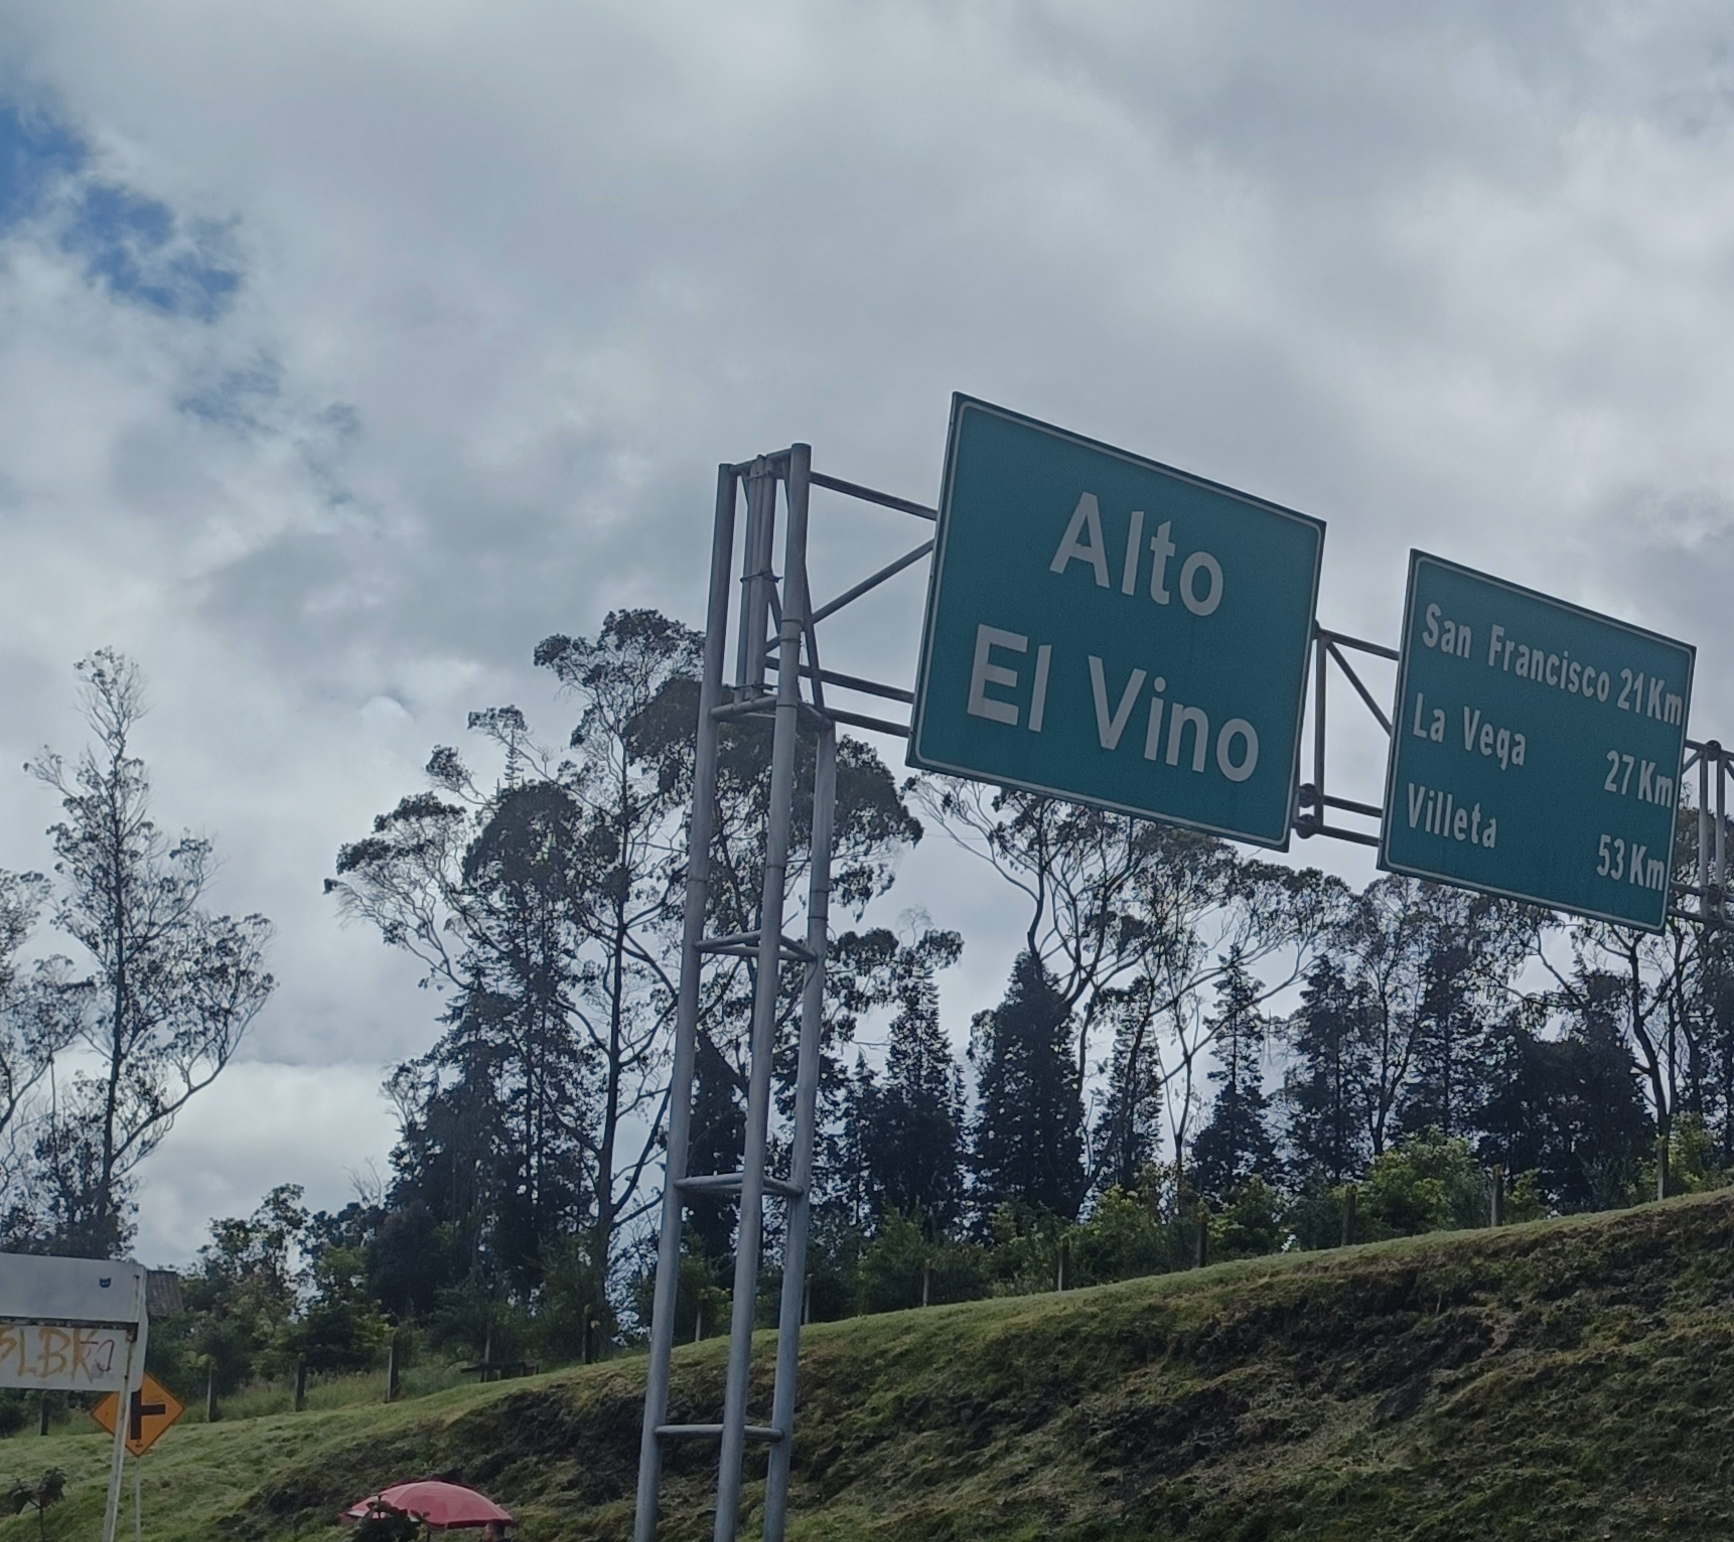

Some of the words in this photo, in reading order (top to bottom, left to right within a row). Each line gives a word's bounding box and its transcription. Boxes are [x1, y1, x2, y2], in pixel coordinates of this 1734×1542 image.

[1049, 491, 1224, 617] Alto
[966, 622, 1052, 733] El
[1088, 654, 1259, 783] Vino
[1421, 602, 1472, 659] San
[1487, 623, 1611, 703] Francisco
[1412, 691, 1446, 743] La
[1462, 705, 1527, 771] Vega
[1407, 781, 1498, 849] Villeta
